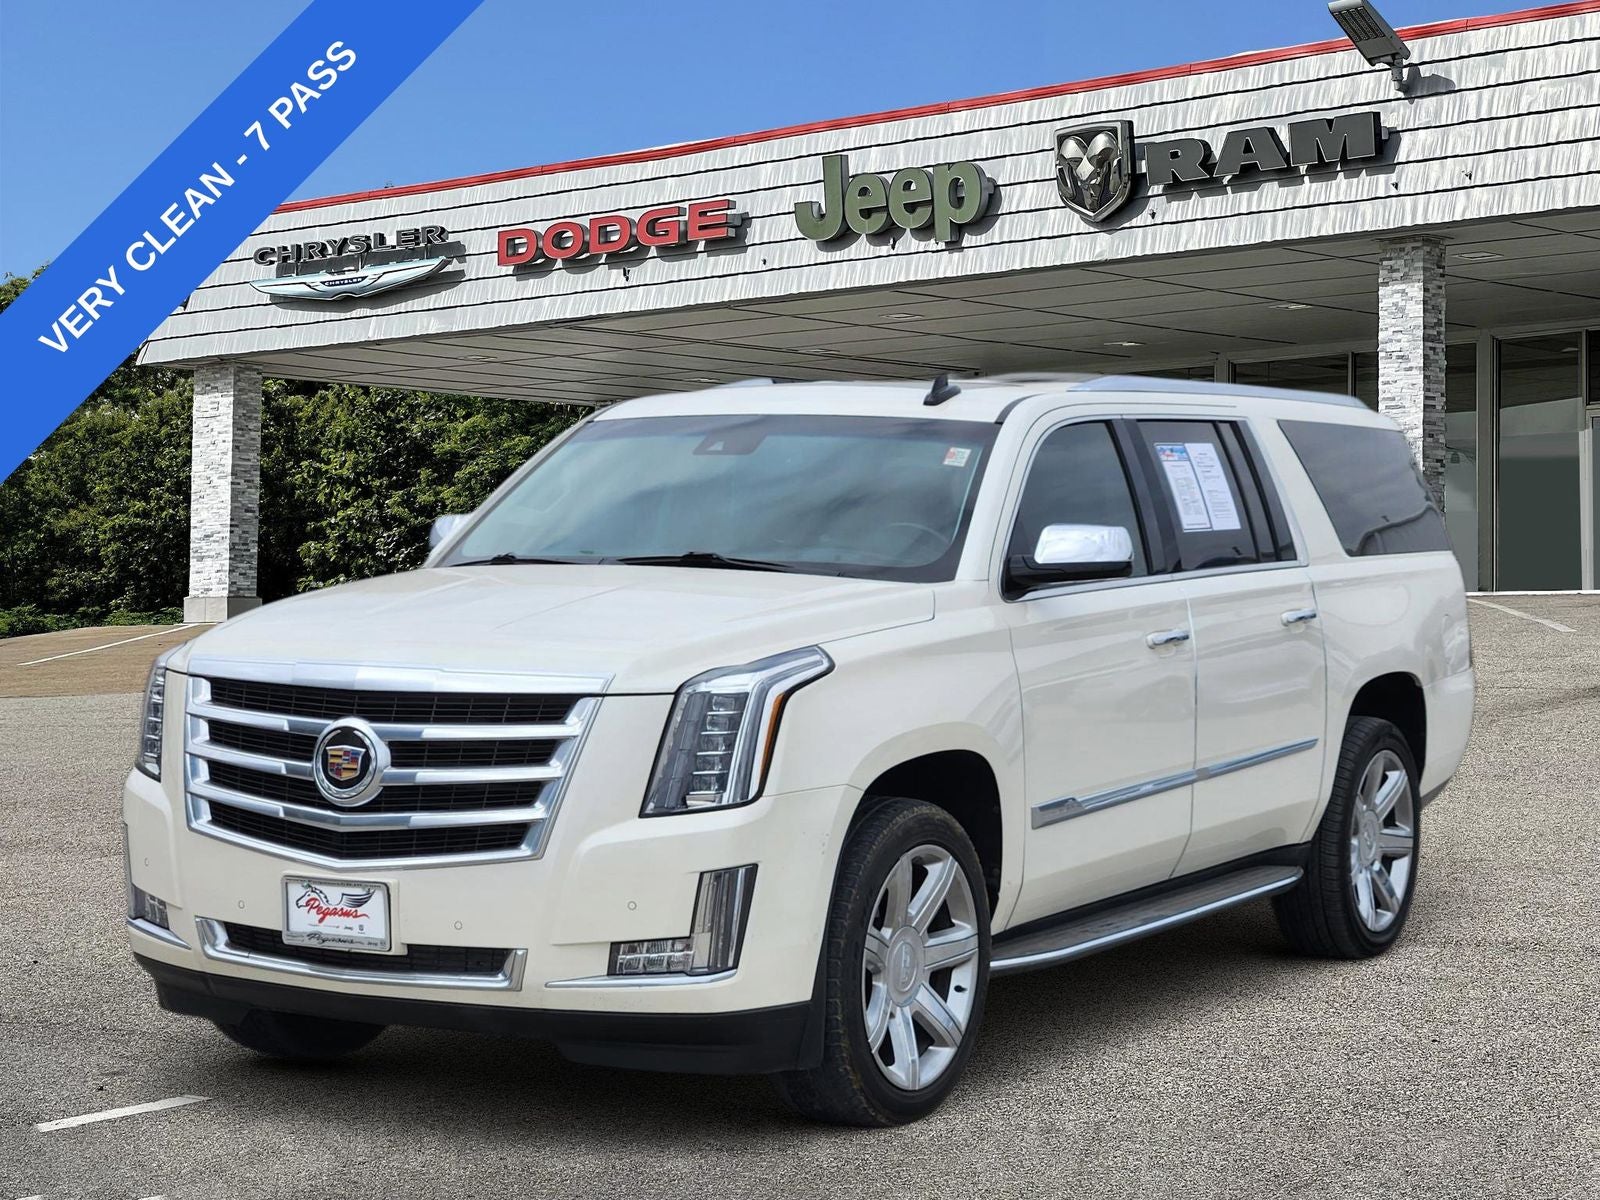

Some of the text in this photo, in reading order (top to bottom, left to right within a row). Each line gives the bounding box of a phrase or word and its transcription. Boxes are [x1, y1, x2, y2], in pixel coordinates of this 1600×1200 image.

[1145, 111, 1381, 186] RAM
[794, 154, 990, 242] Jeep
[253, 225, 447, 266] CHRYSLER
[498, 199, 736, 267] DODGE
[324, 277, 363, 286] CHRYSLER
[305, 897, 370, 924] Pegasus
